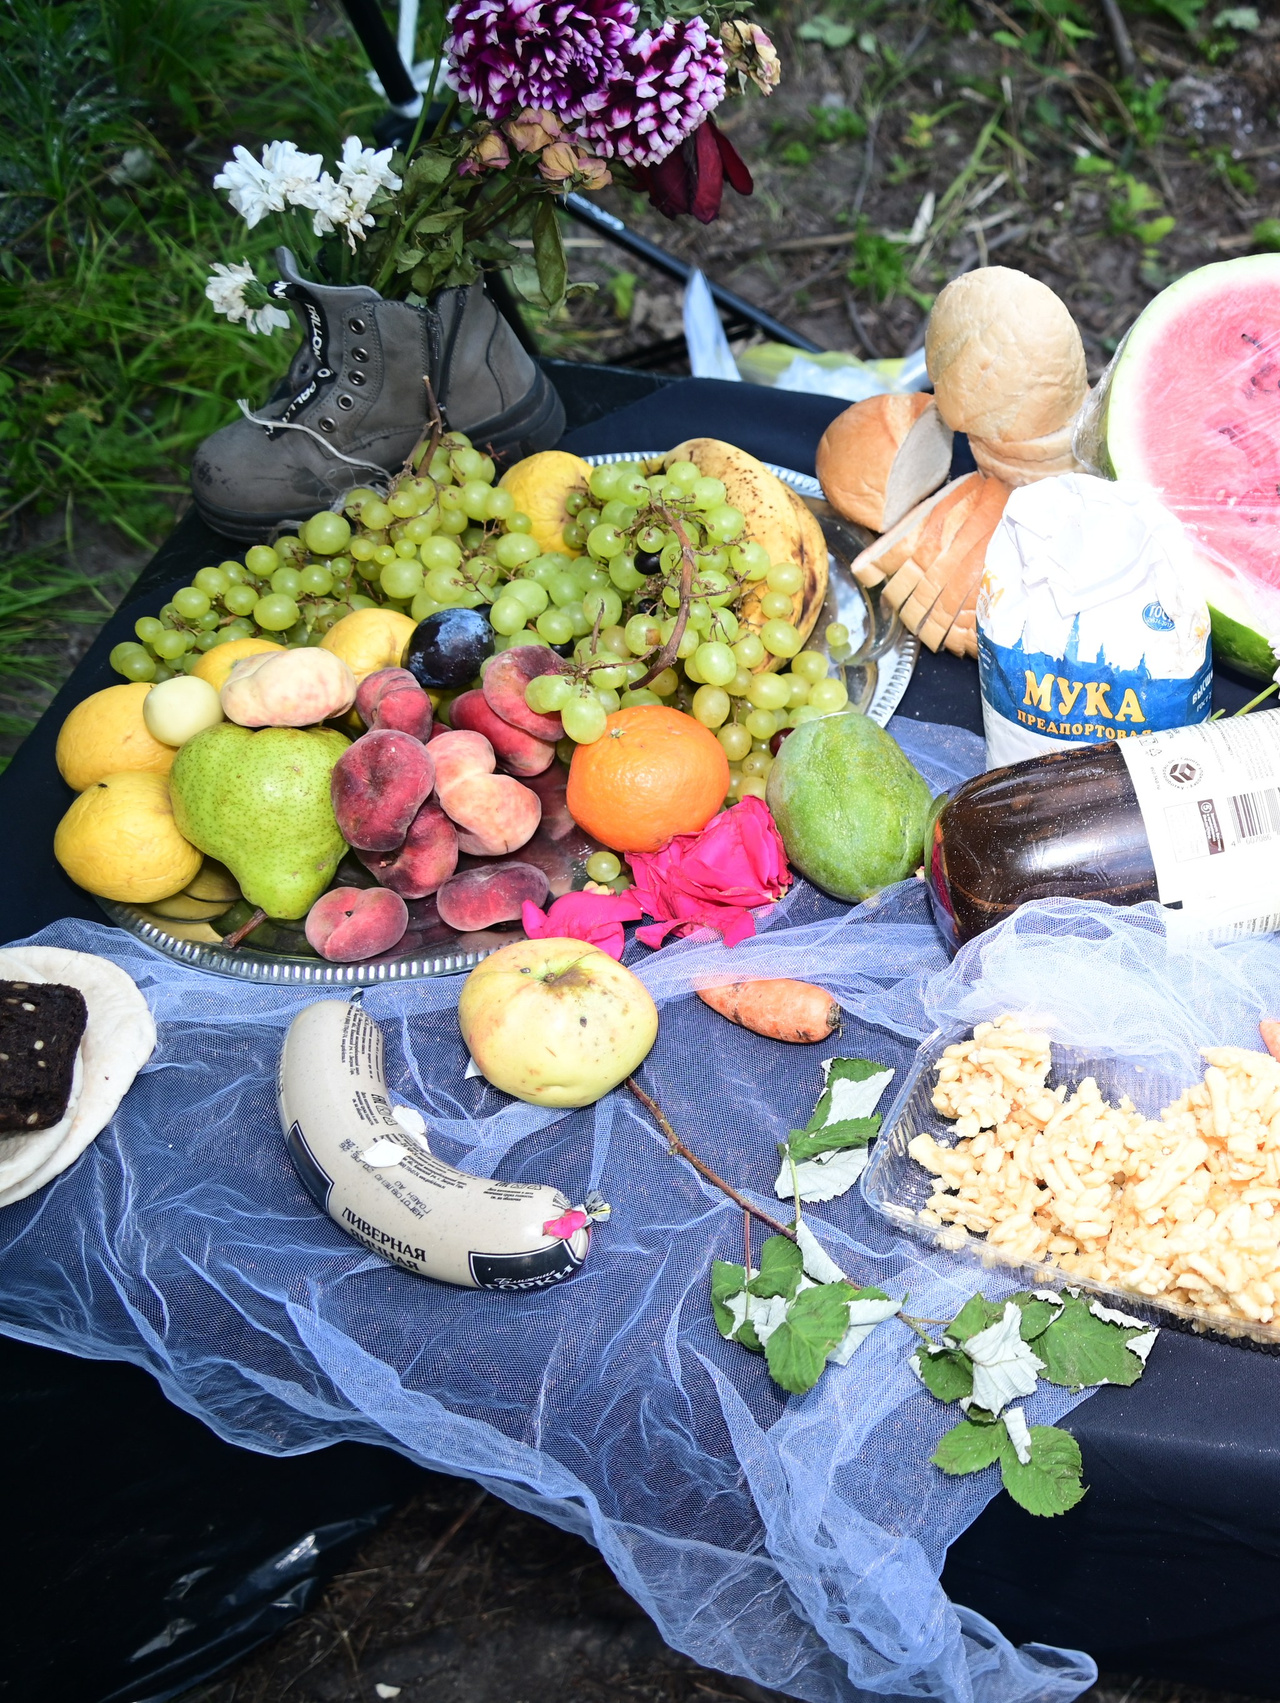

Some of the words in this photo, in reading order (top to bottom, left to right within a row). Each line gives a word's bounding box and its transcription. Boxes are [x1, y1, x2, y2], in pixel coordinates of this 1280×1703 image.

[1022, 670, 1147, 723] МУКА
[342, 1206, 427, 1262] ЛИВЕРНАЯ
[350, 1228, 421, 1271] ЯИЧНАЯ
[485, 1265, 575, 1291] ГОРКИ
